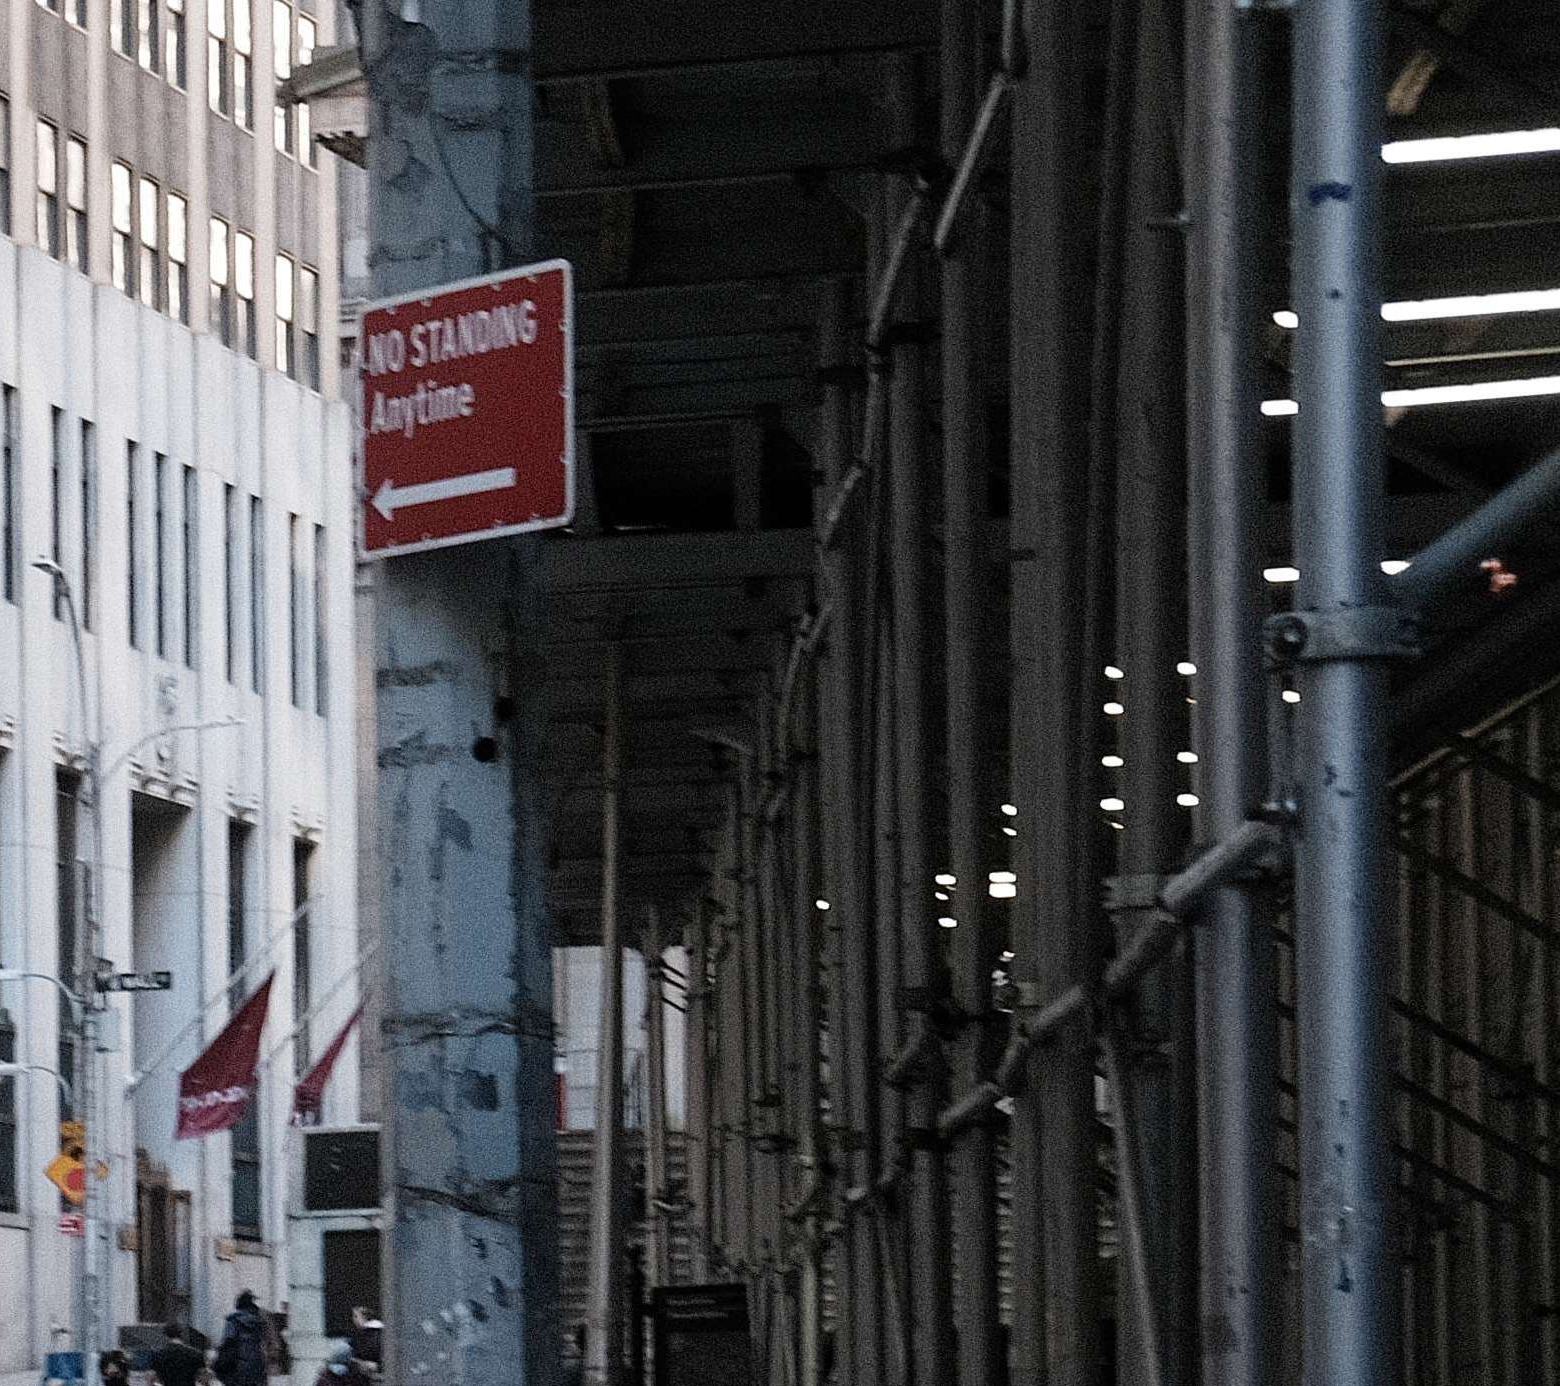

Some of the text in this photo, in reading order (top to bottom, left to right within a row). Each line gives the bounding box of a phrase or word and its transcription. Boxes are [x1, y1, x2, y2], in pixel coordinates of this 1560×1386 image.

[368, 299, 538, 376] NO STANDING
[370, 380, 476, 438] Anytime
